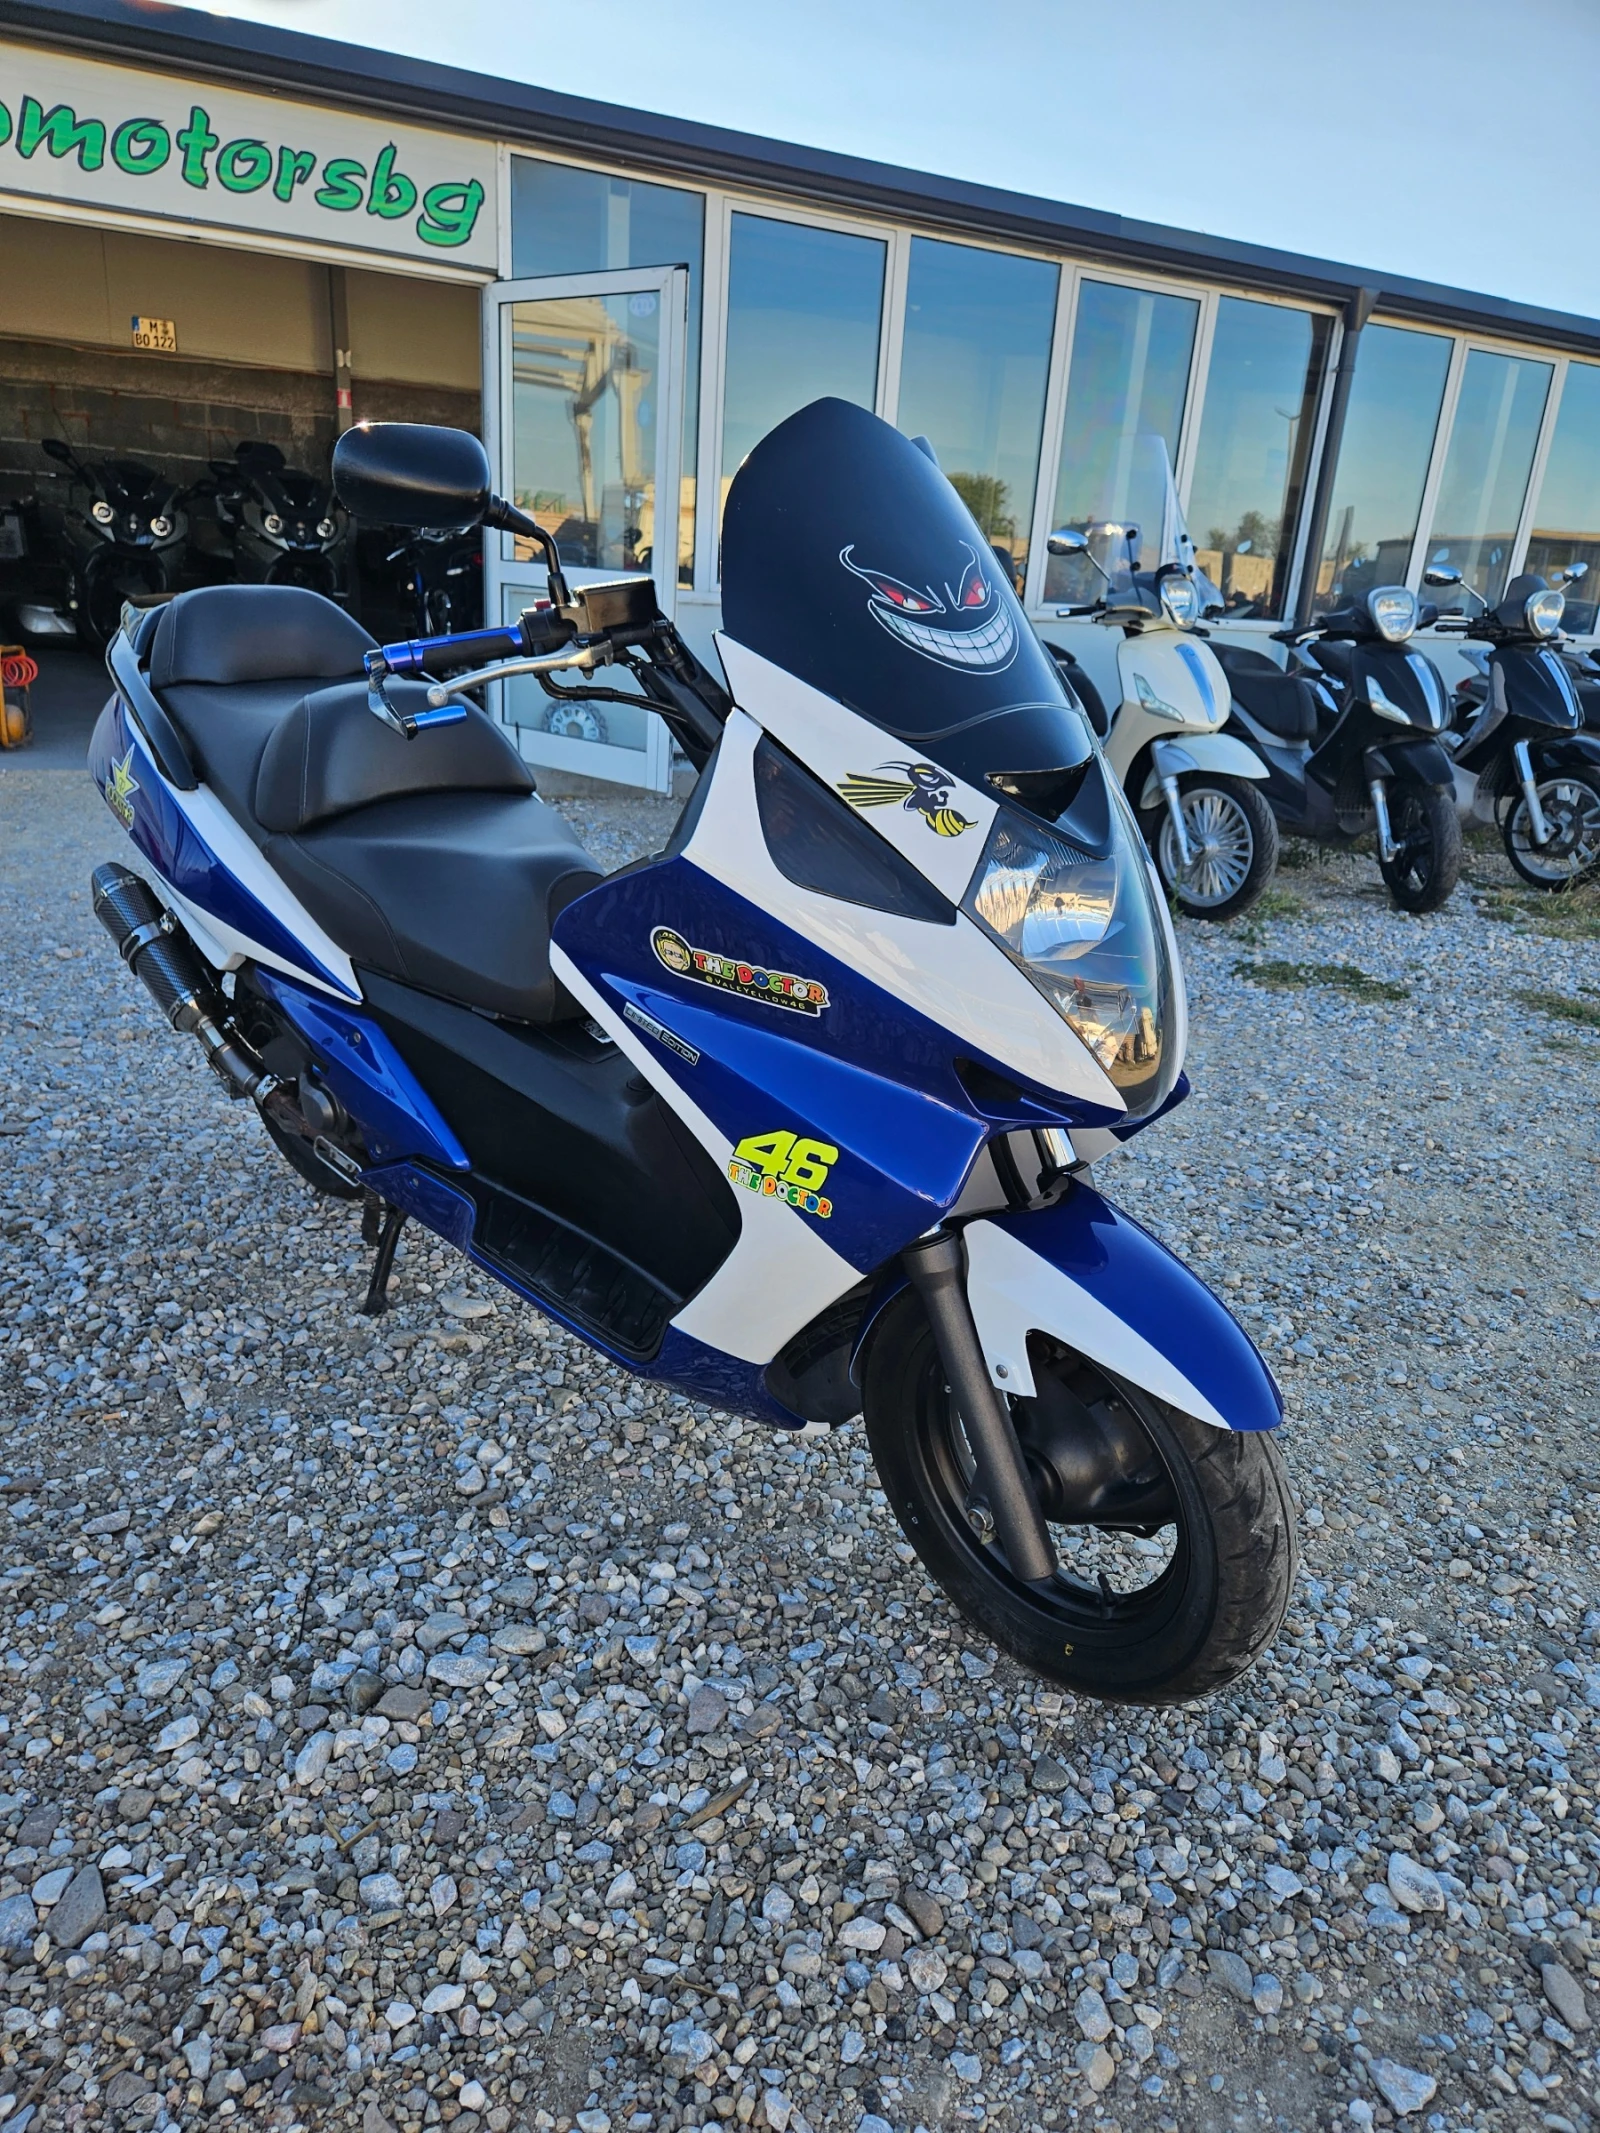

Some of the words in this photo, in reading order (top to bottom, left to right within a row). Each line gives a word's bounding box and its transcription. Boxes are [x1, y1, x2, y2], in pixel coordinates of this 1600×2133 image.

[0, 95, 484, 247] motorsbg
[149, 320, 158, 333] M
[693, 952, 735, 980] THE
[736, 965, 828, 1005] DOCTOR
[625, 1006, 660, 1035] LIMITED
[661, 1032, 697, 1062] EDITION
[732, 1129, 839, 1191] 46
[728, 1161, 762, 1193] THE
[762, 1176, 833, 1218] DOCTOR
